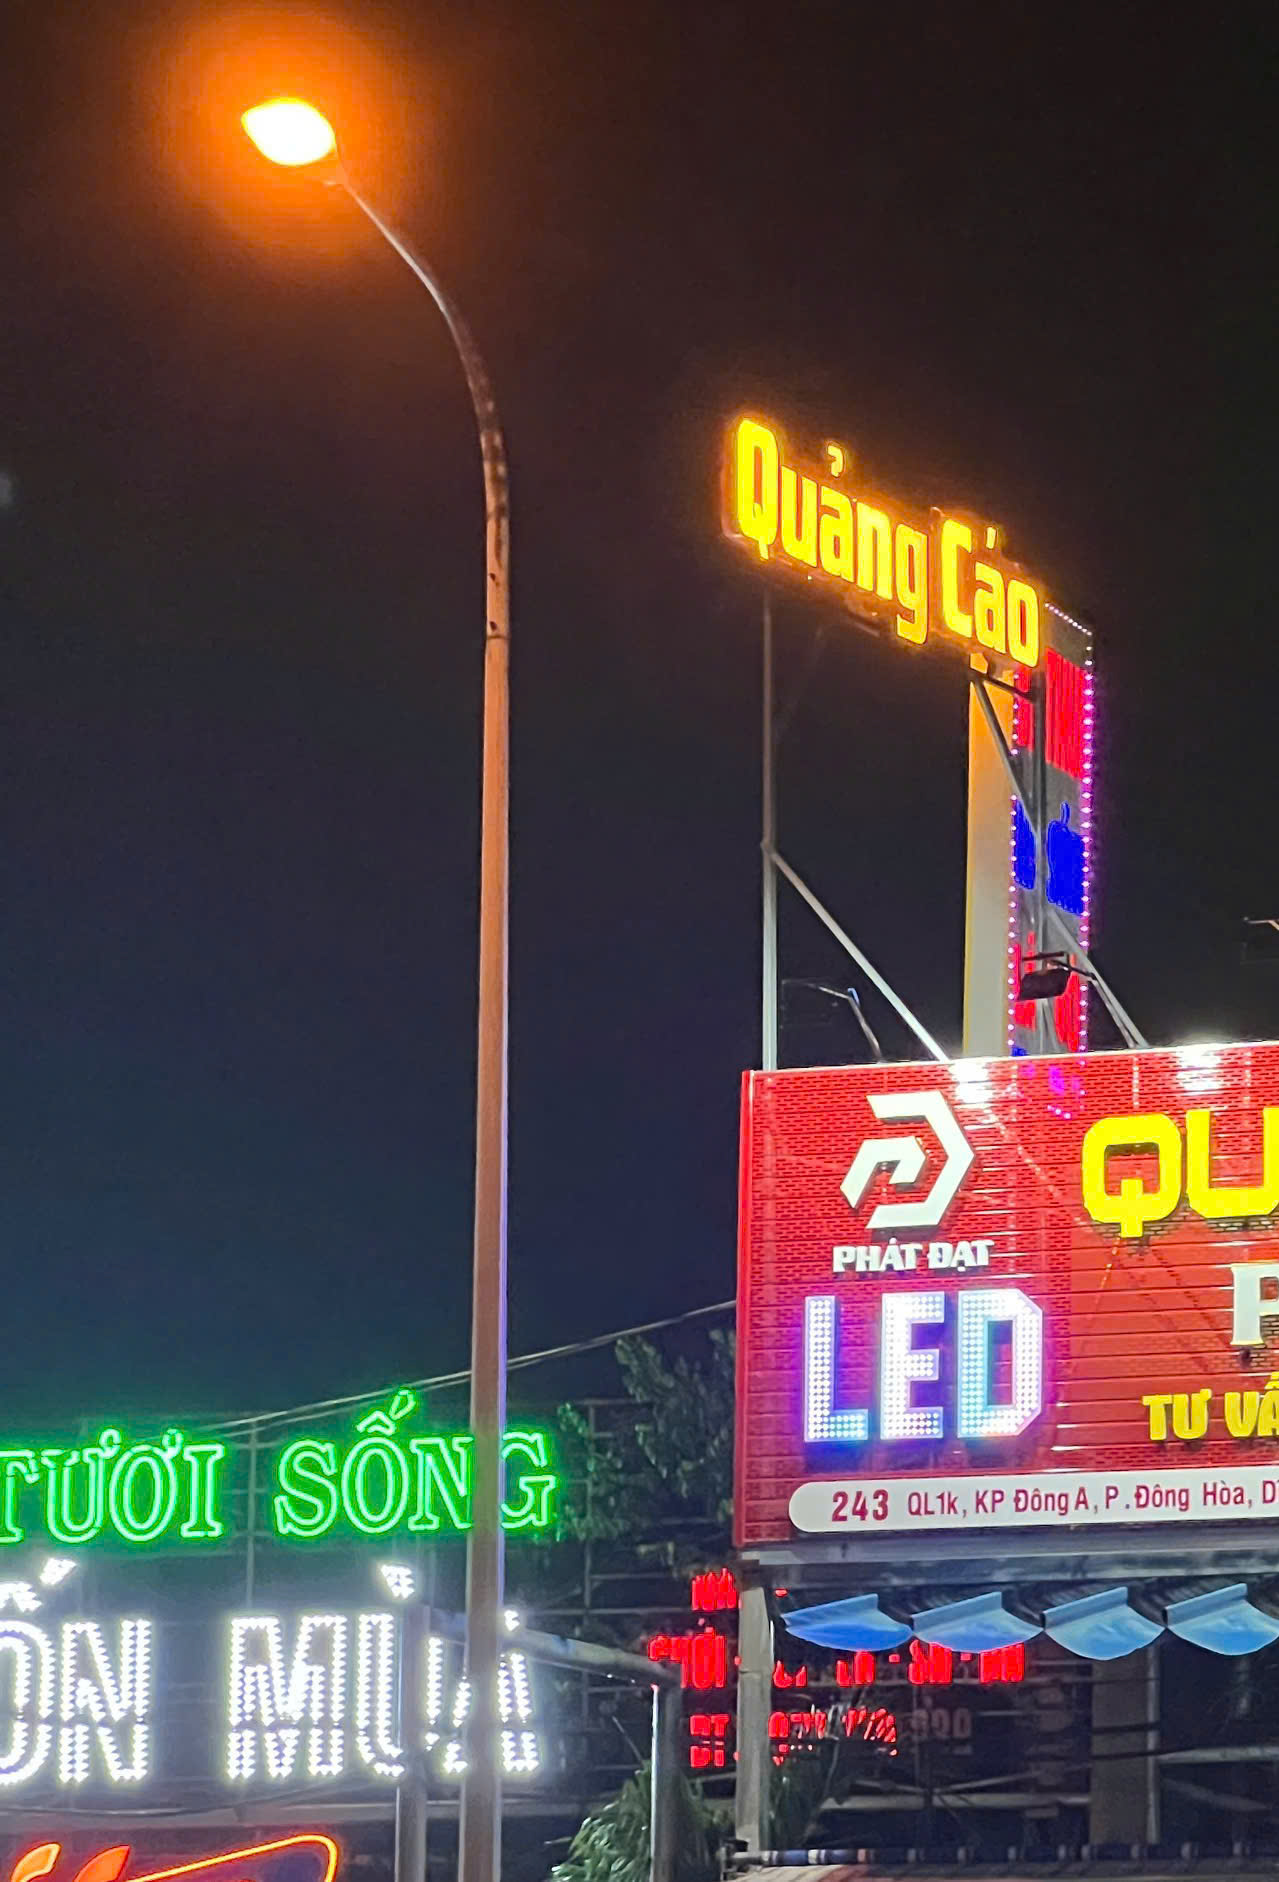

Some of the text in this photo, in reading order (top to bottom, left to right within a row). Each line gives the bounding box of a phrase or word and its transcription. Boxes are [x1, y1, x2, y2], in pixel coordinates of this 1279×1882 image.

[738, 419, 1040, 668] Quảng Cáo
[833, 1237, 995, 1273] PHÁT ĐẠT
[803, 1287, 1044, 1443] LED
[1142, 1387, 1212, 1441] TƯ
[273, 1387, 558, 1538] SỐNG
[831, 1489, 889, 1522] 243
[975, 1489, 1005, 1515] KP
